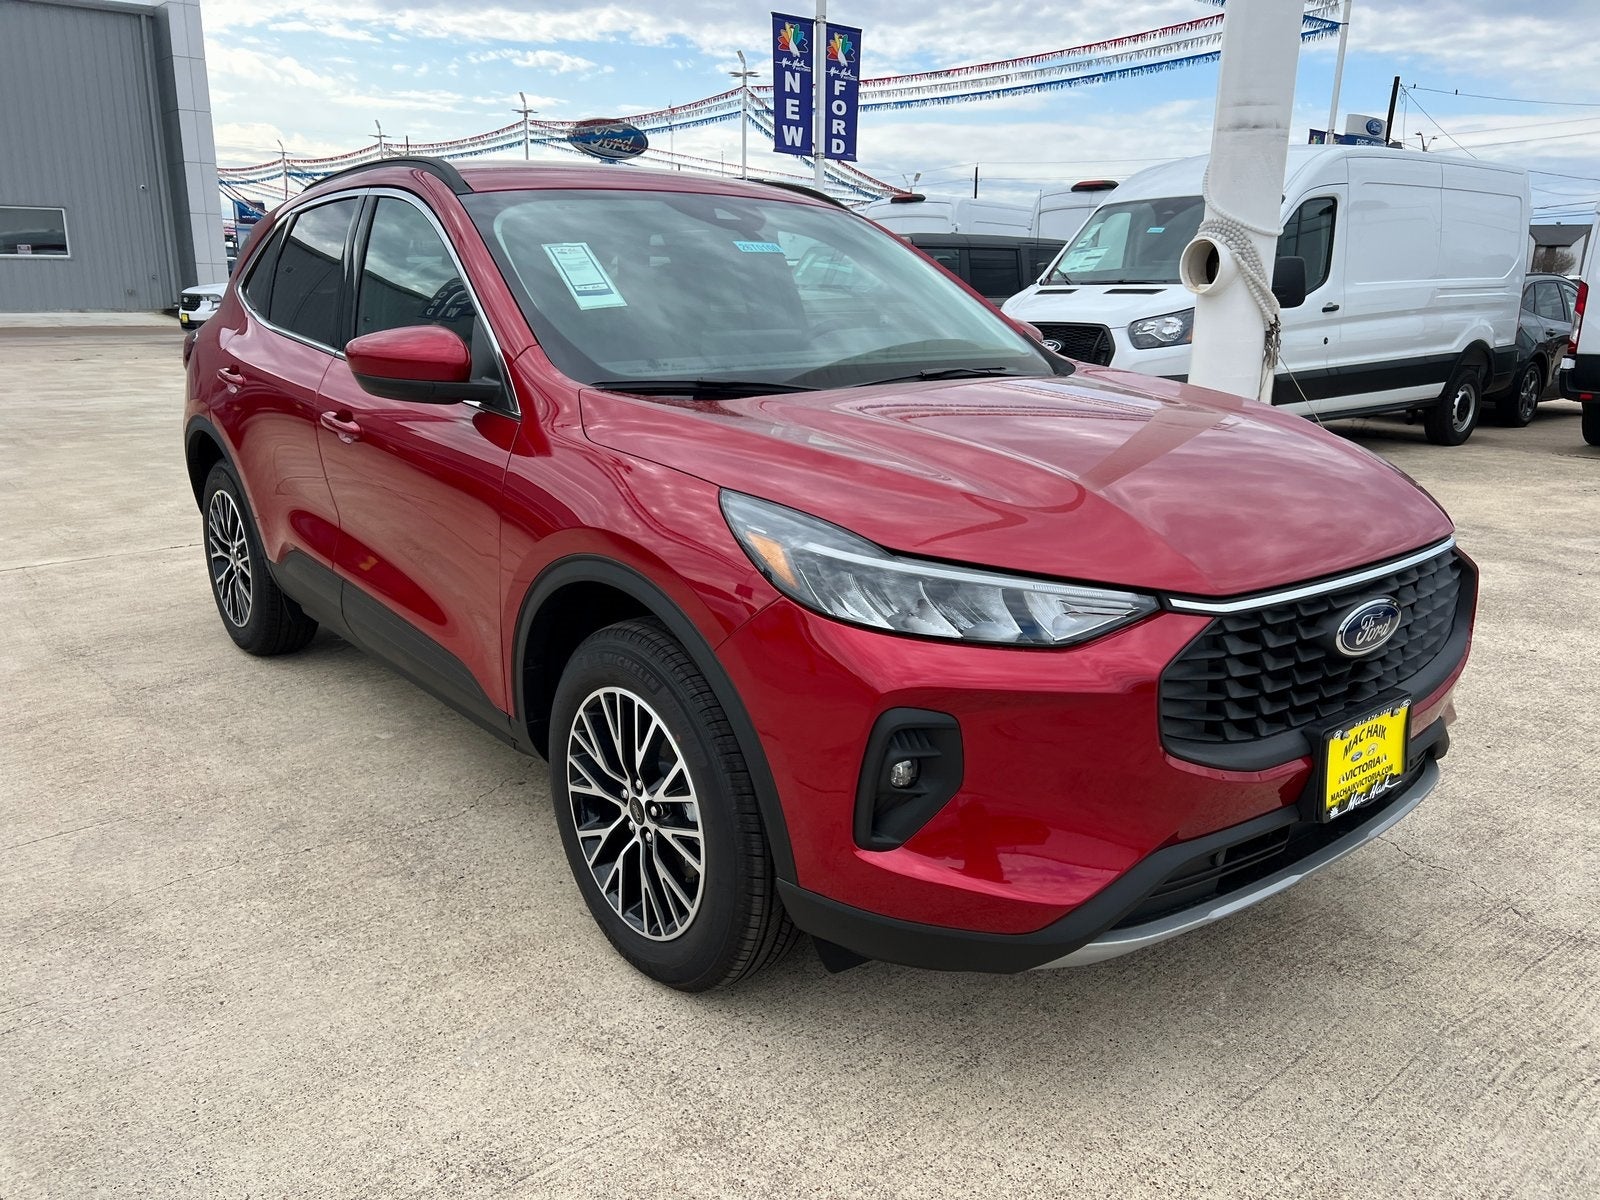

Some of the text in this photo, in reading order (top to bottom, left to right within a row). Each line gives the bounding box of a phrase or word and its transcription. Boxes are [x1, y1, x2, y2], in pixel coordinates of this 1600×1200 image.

[782, 71, 804, 147] NEW
[831, 80, 847, 155] FORD
[590, 126, 635, 152] Ford
[1355, 610, 1392, 646] Ford
[1342, 728, 1365, 760] MAC
[1366, 723, 1387, 740] HAIK
[1330, 763, 1394, 802] MACHAIKVICTORIA.COM
[1345, 755, 1381, 782] VICTORIA
